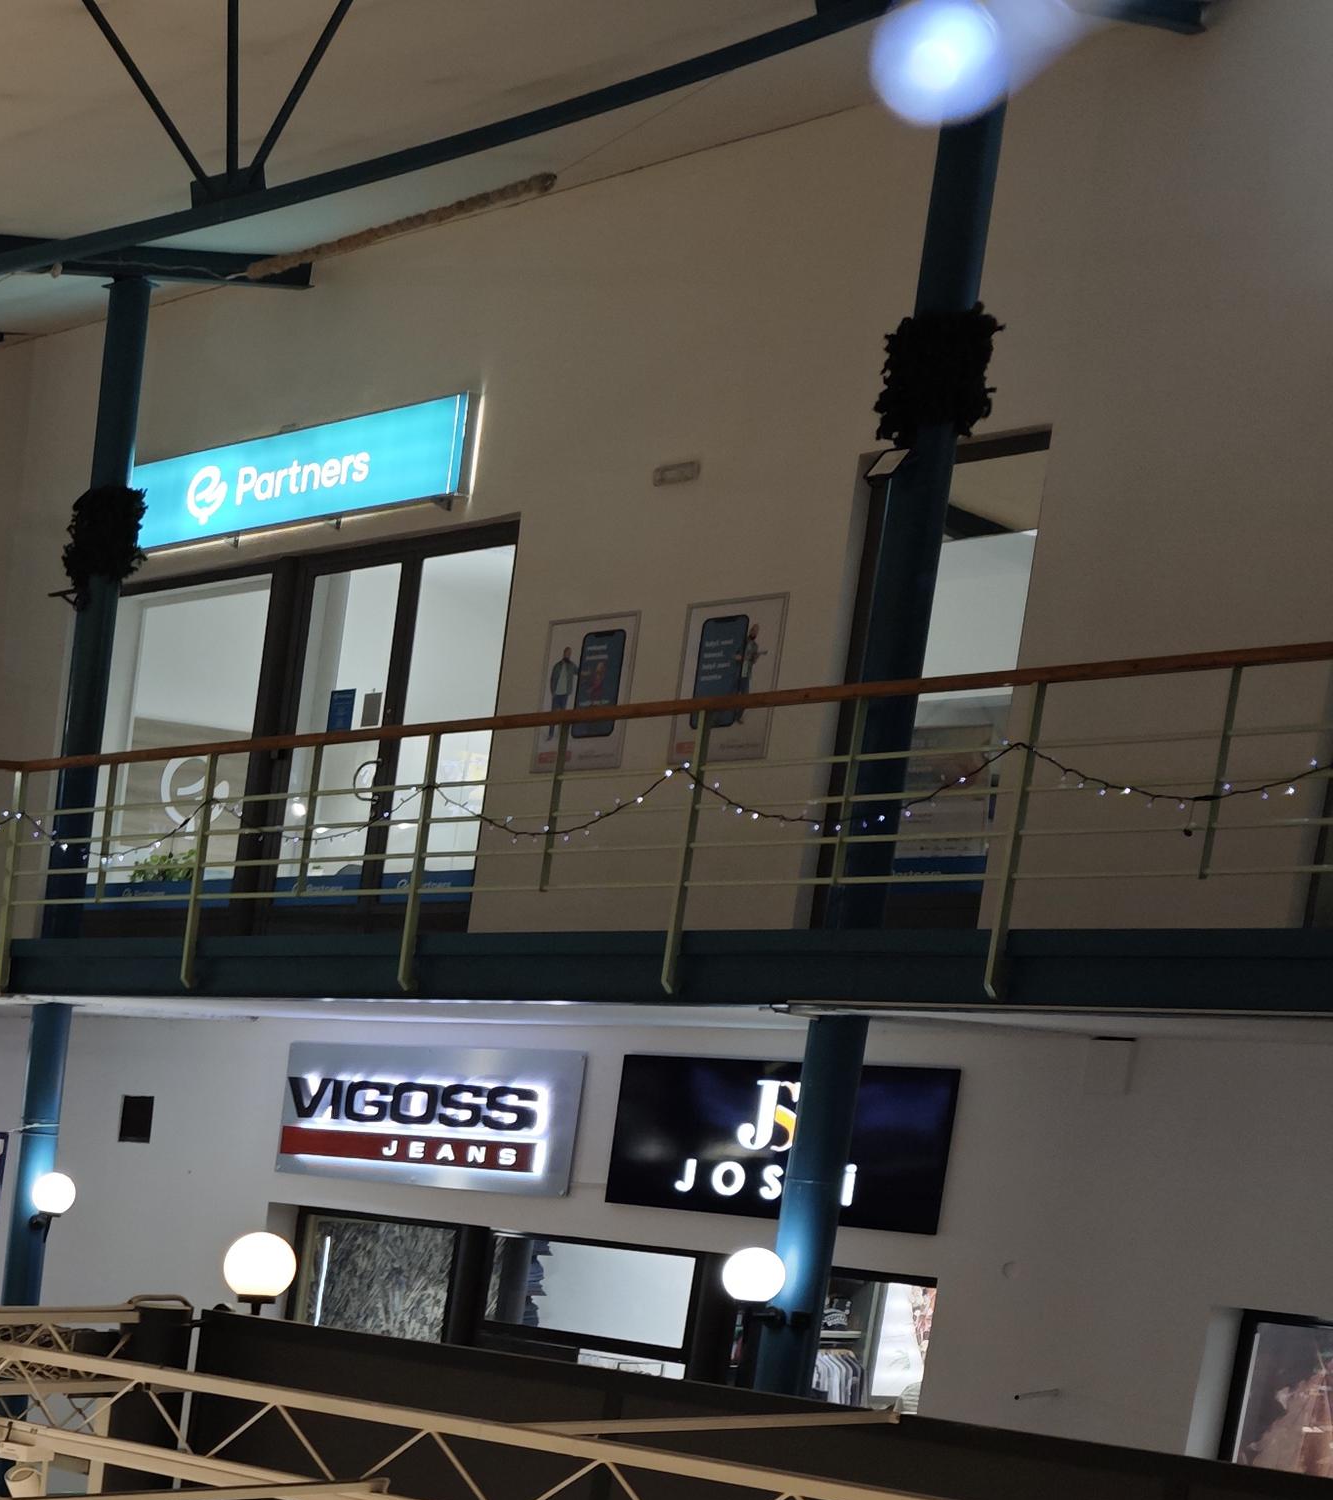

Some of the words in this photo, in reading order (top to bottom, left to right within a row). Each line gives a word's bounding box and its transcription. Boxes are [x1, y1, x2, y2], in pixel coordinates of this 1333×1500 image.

[234, 451, 371, 506] Partners
[288, 1075, 539, 1131] VIGOSS
[381, 1138, 518, 1165] JEANS
